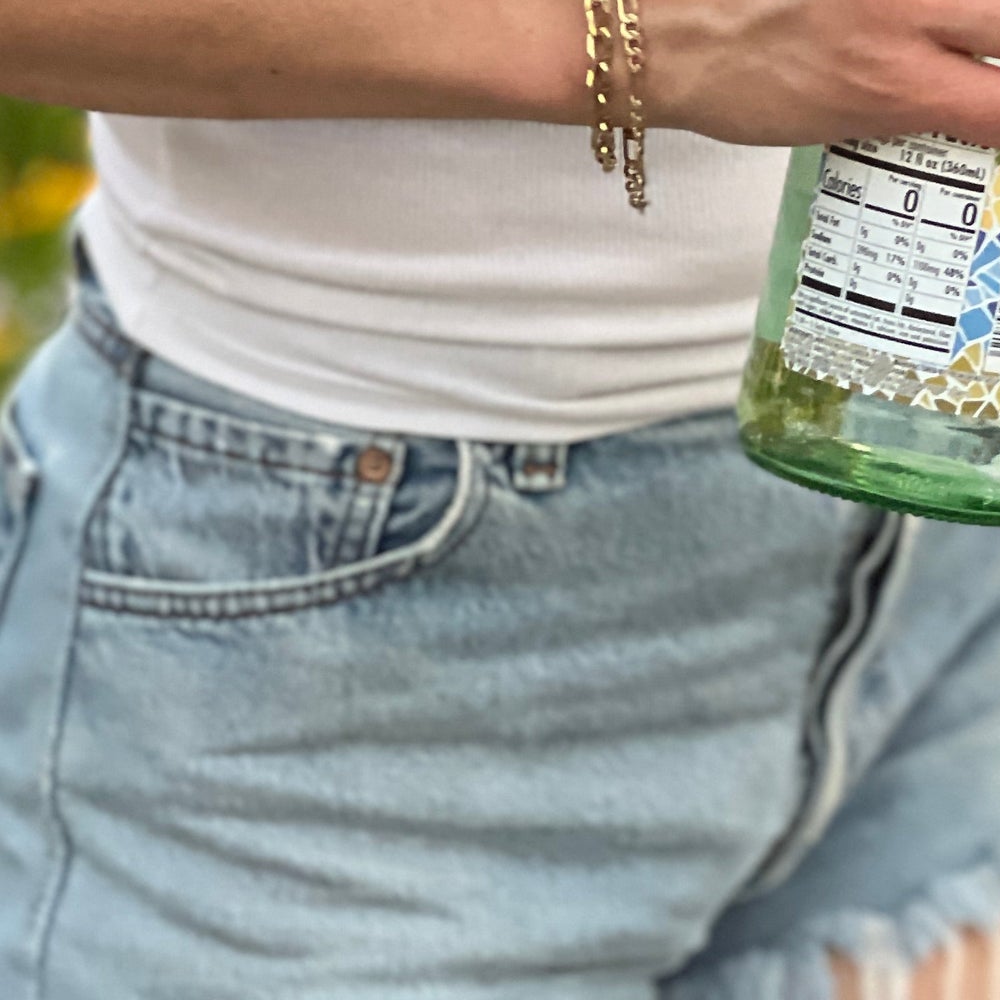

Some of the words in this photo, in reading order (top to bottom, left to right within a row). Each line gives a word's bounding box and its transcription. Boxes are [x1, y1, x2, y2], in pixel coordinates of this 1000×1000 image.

[900, 149, 913, 164] 12
[925, 160, 938, 170] oz
[823, 168, 863, 199] Calories
[903, 189, 919, 213] 0
[961, 202, 978, 226] 0
[894, 235, 910, 247] 0%
[886, 252, 905, 266] 17%
[952, 249, 969, 261] 0%
[886, 271, 902, 284] 0%
[943, 267, 965, 280] 48%
[944, 285, 960, 297] 0%
